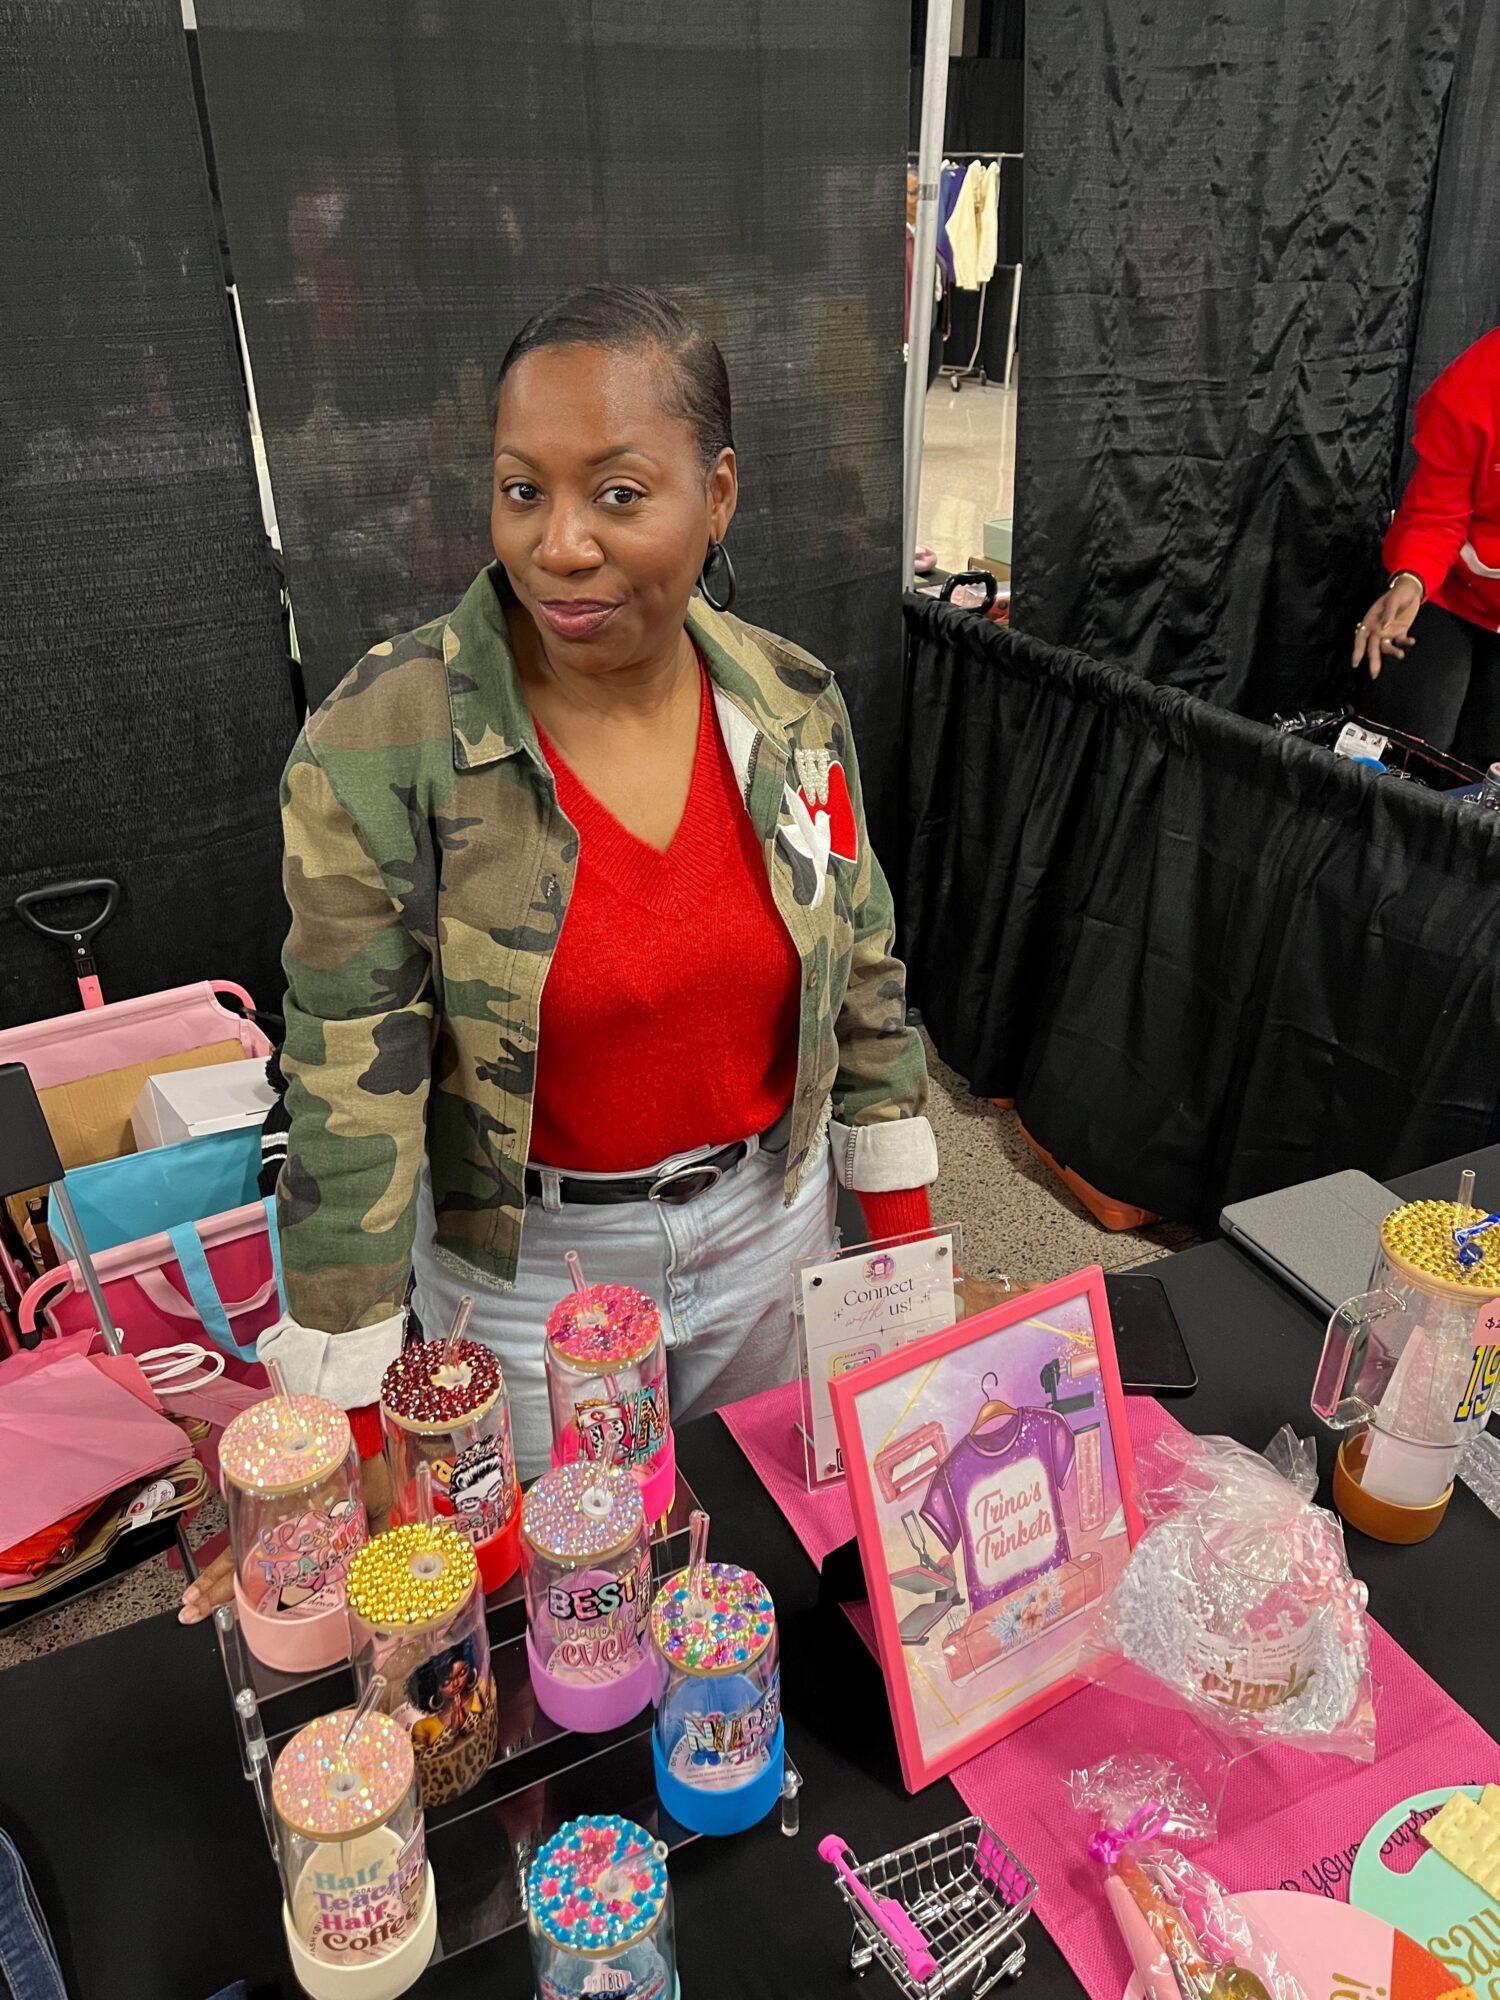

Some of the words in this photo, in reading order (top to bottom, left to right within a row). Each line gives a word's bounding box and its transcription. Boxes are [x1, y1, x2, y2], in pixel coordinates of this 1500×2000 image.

[844, 1278, 913, 1307] Connect
[845, 1298, 886, 1330] with
[889, 1297, 913, 1317] us!
[975, 1482, 1042, 1531] Trina's
[976, 1510, 1052, 1568] Trinkets
[548, 1566, 638, 1621] BEST
[315, 1858, 384, 1890] Half
[322, 1899, 389, 1931] Half
[322, 1901, 416, 1952] Coffee
